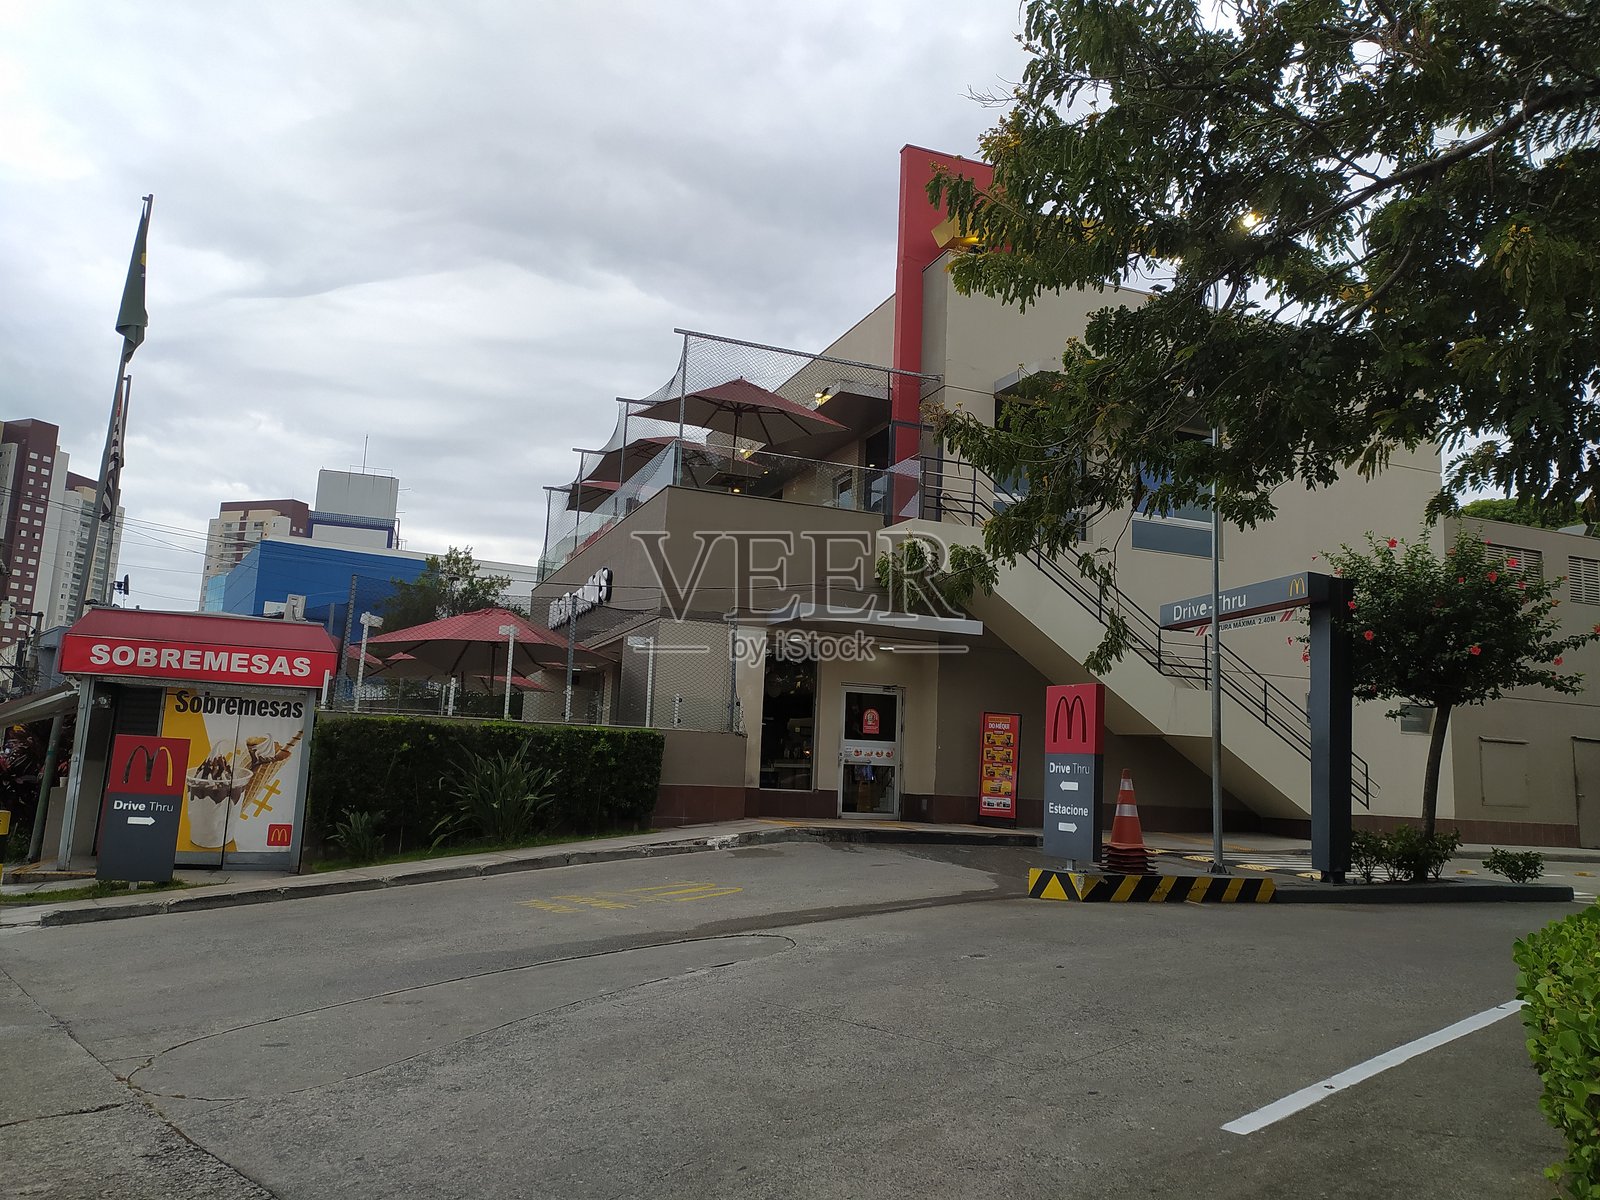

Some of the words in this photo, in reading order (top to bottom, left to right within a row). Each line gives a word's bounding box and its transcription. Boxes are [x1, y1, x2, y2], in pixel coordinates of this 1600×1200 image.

[1258, 615, 1276, 625] 2.40M
[89, 644, 311, 677] SOBREMESAS
[175, 690, 304, 719] Sobremesas
[1049, 762, 1071, 774] Drive
[1072, 763, 1090, 775] Thru
[113, 800, 146, 811] Drive
[149, 801, 174, 812] Thru
[1048, 802, 1089, 817] Estacione
